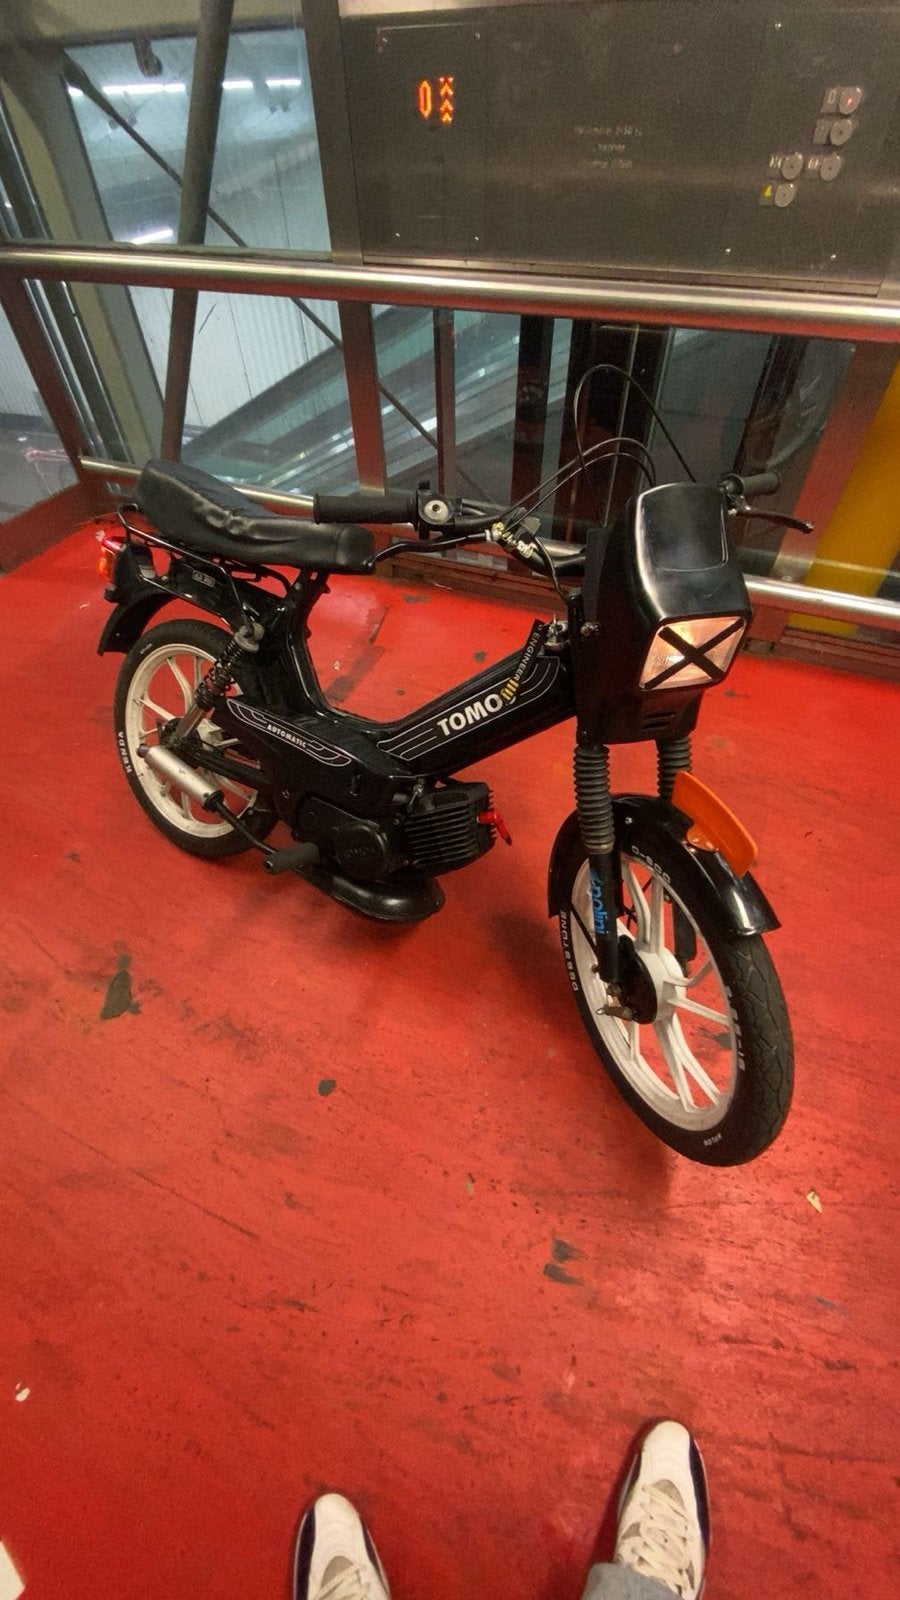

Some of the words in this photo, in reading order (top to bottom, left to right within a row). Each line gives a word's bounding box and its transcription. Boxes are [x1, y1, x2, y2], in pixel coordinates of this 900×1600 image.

[513, 631, 540, 682] ENGINEER
[436, 691, 517, 736] TOMO
[117, 731, 132, 773] KENDA
[266, 723, 307, 749] AUTOMATIC
